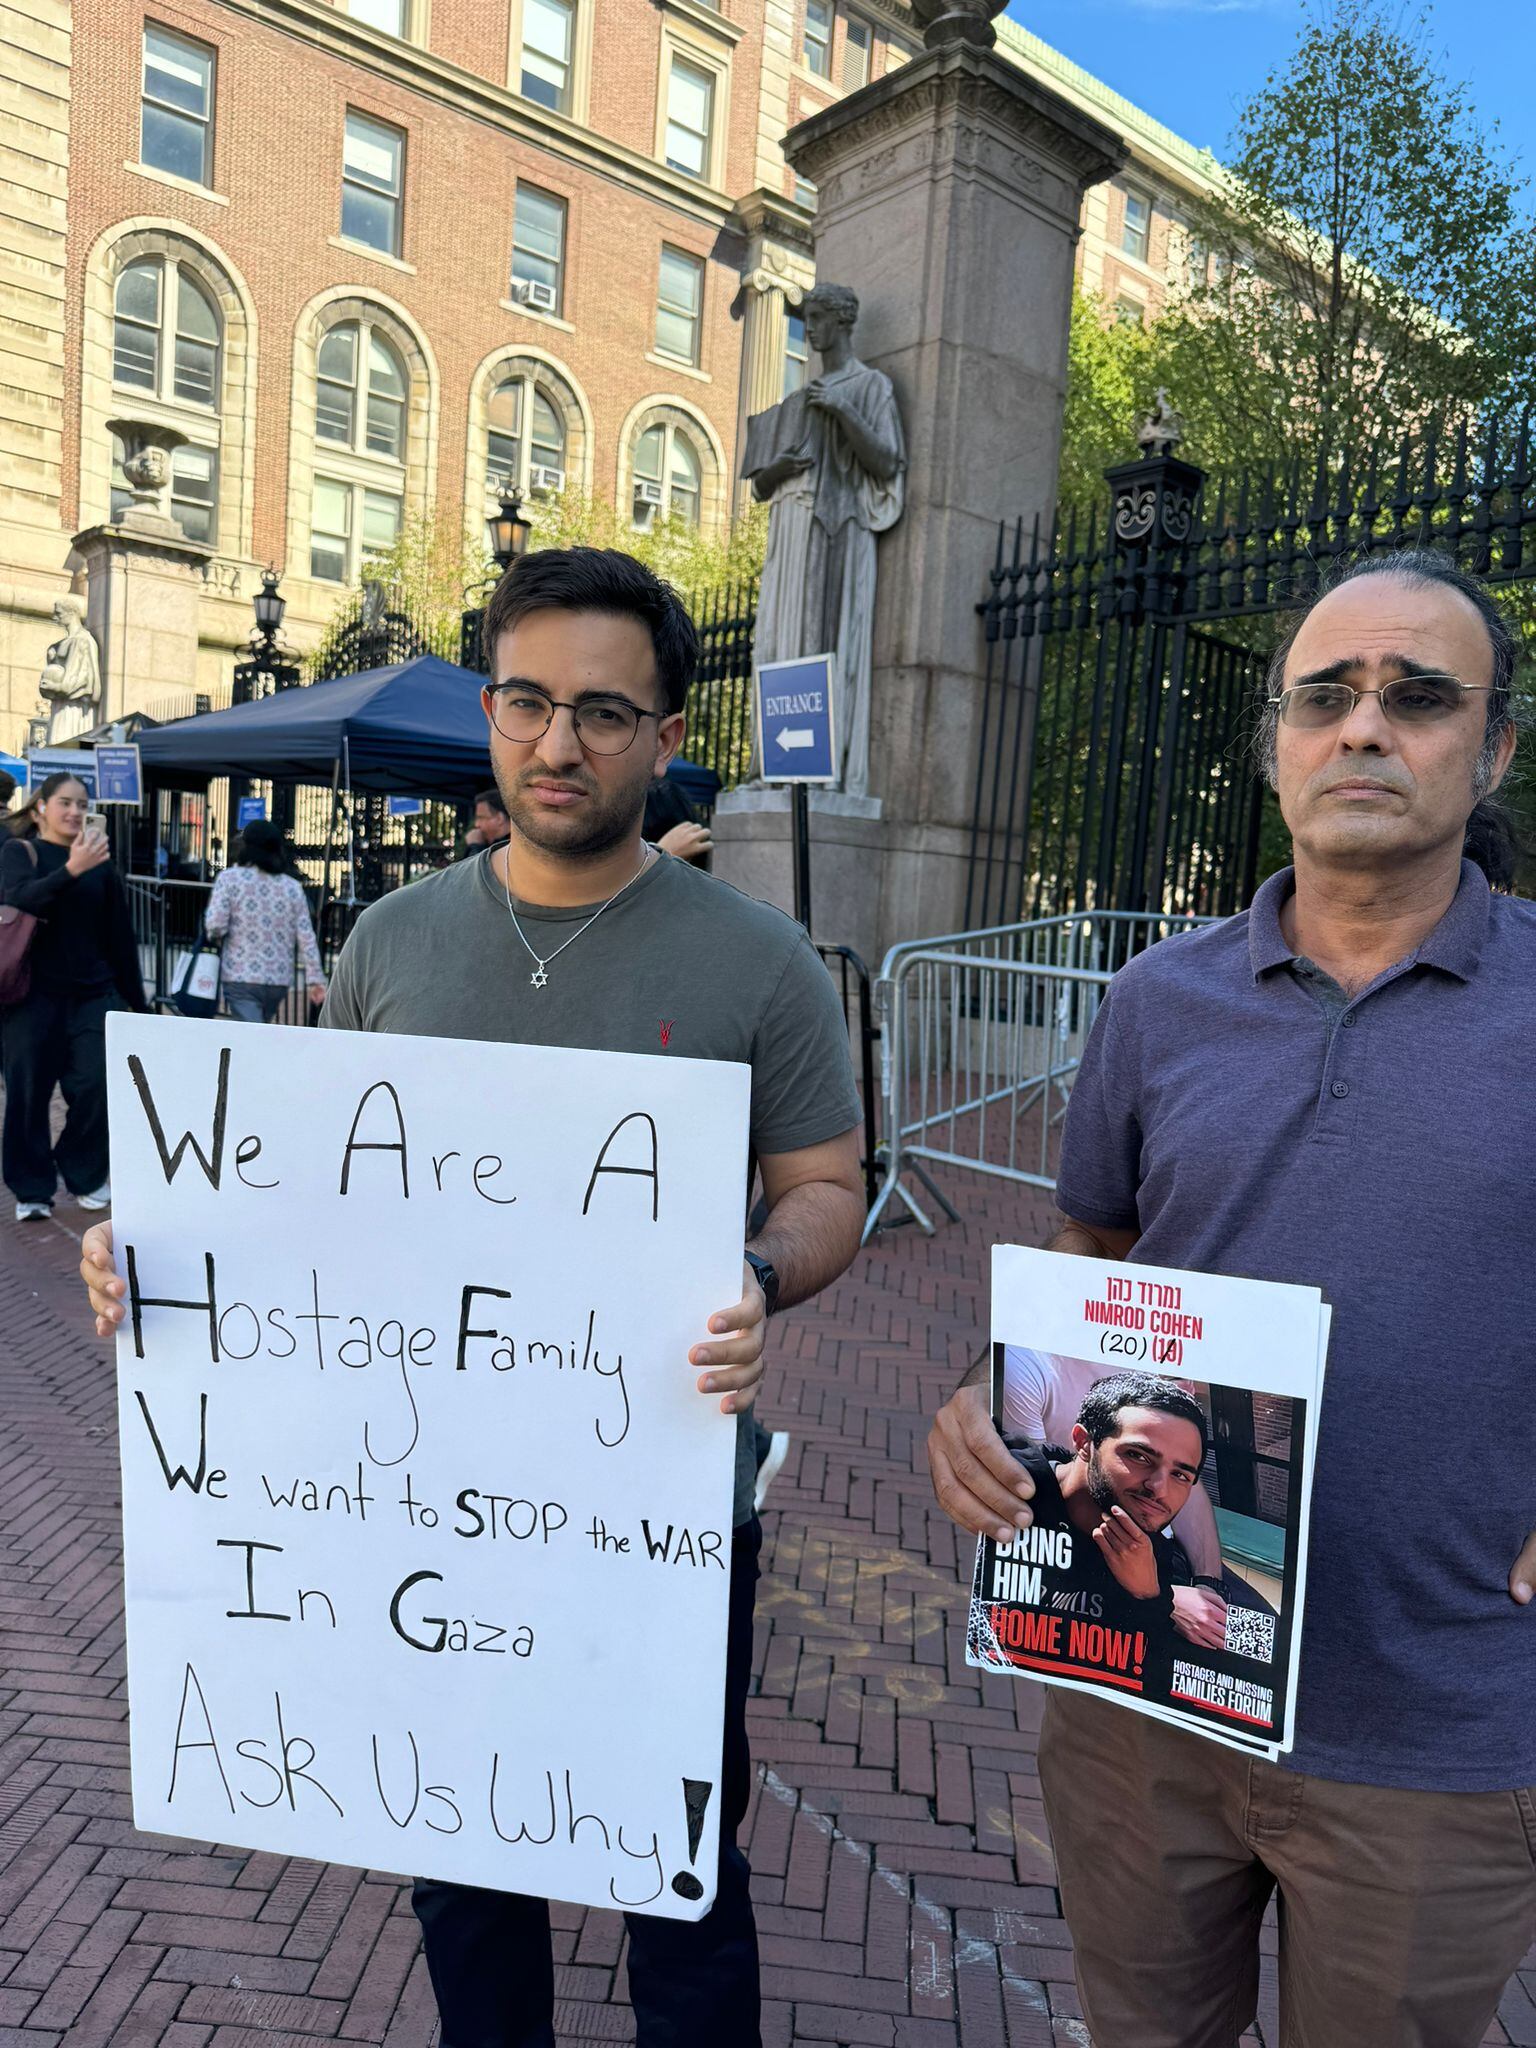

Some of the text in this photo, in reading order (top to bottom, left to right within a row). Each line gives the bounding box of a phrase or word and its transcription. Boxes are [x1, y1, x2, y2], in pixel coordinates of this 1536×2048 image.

[766, 692, 823, 716] ENTRANCE
[128, 1048, 658, 1222] We Are A
[1107, 1277, 1182, 1310] נמרוד כהן
[1084, 1299, 1203, 1340] NIMROD COHEN
[126, 1245, 630, 1466] Hostage Family
[1100, 1330, 1148, 1361] (20)
[135, 1390, 726, 1570] We want to STOP the WAR
[216, 1539, 535, 1657] In Gaza
[992, 1560, 1042, 1606] HIM
[990, 1605, 1145, 1675] HOME NOW!
[1172, 1673, 1273, 1722] FAMILIES FORUM
[1173, 1659, 1274, 1703] HOSTAGES AND MISSING
[167, 1662, 713, 1906] Ask Us Why!
